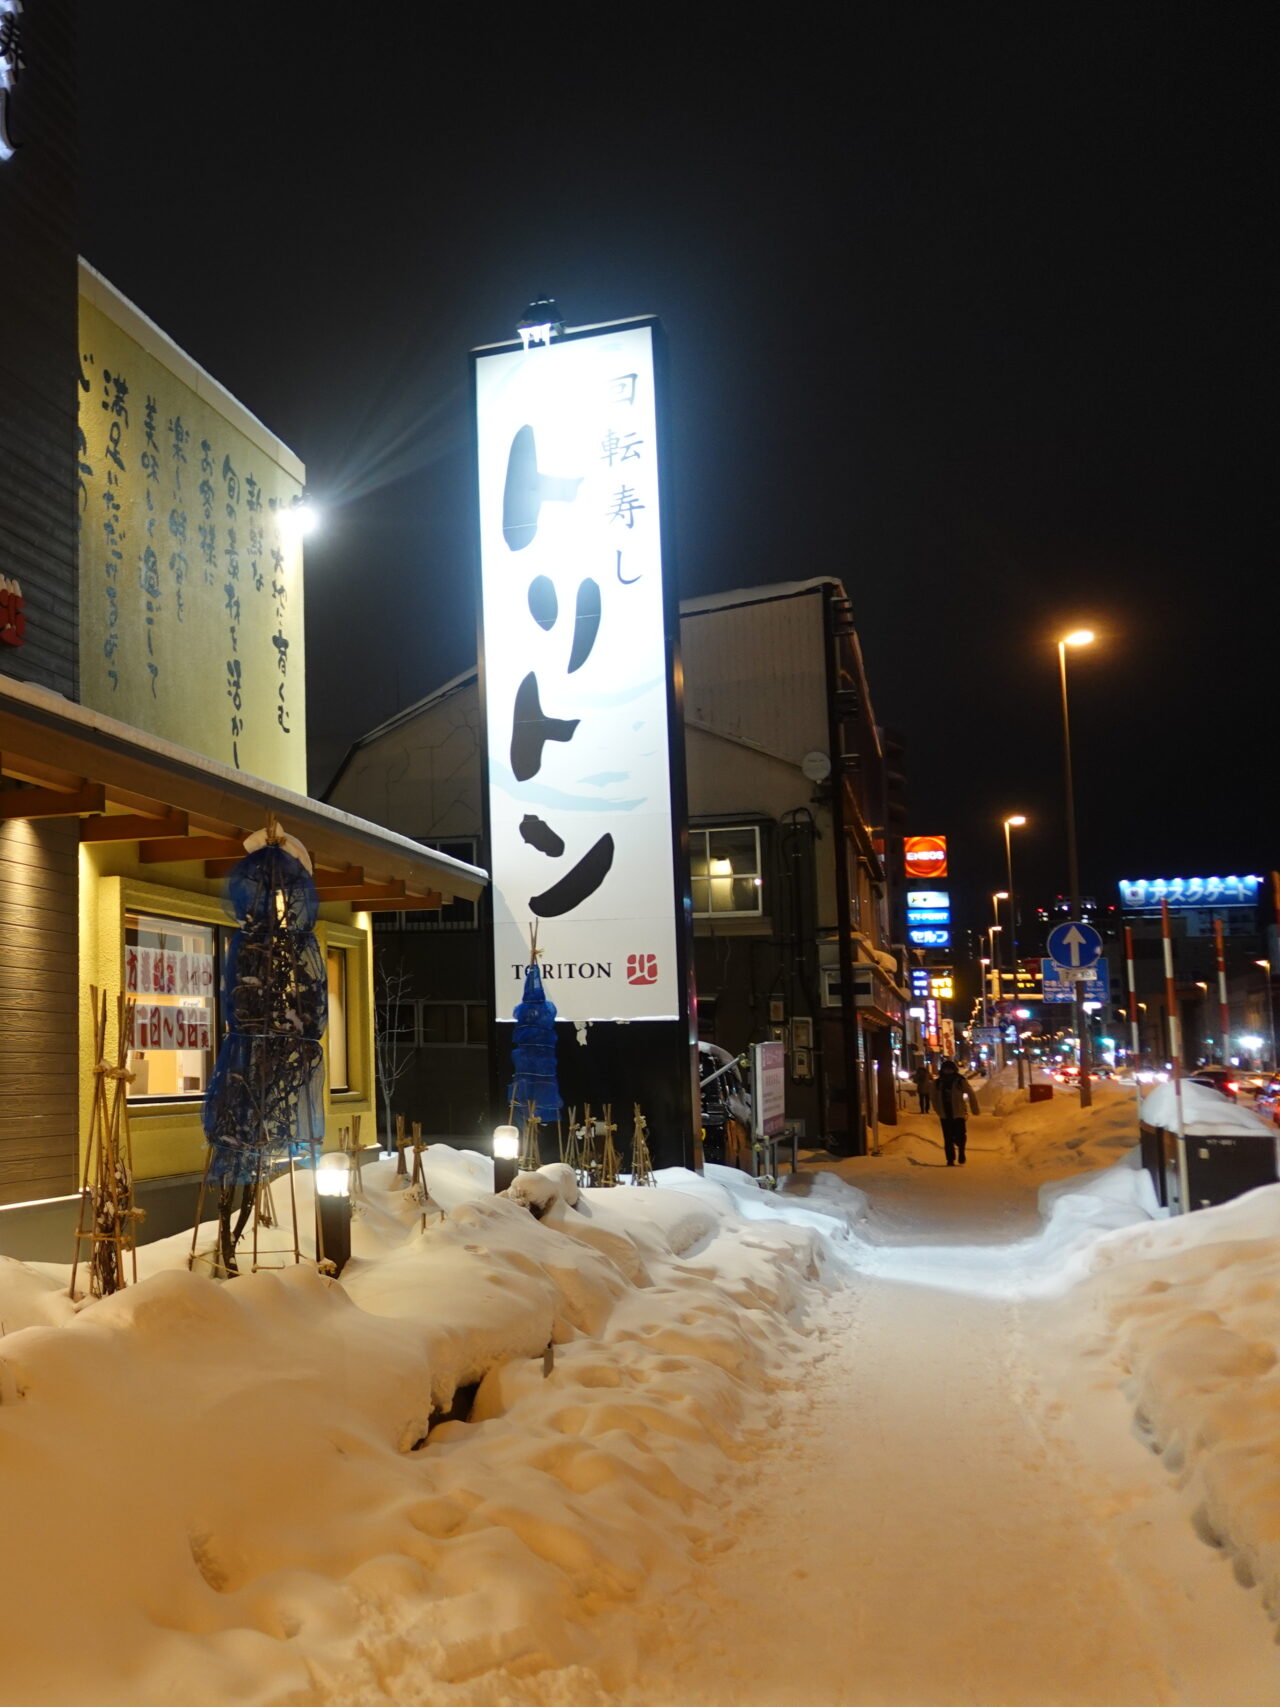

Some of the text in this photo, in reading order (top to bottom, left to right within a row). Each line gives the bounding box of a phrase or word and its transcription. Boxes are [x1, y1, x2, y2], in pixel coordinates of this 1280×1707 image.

[599, 372, 646, 585] 回転寿し
[198, 439, 218, 587] お客様に
[502, 424, 616, 919] トリトン
[906, 851, 945, 860] ENEOS
[1149, 882, 1253, 903] アスクゲート
[910, 930, 949, 943] セルフ
[511, 962, 613, 980] TRITON
